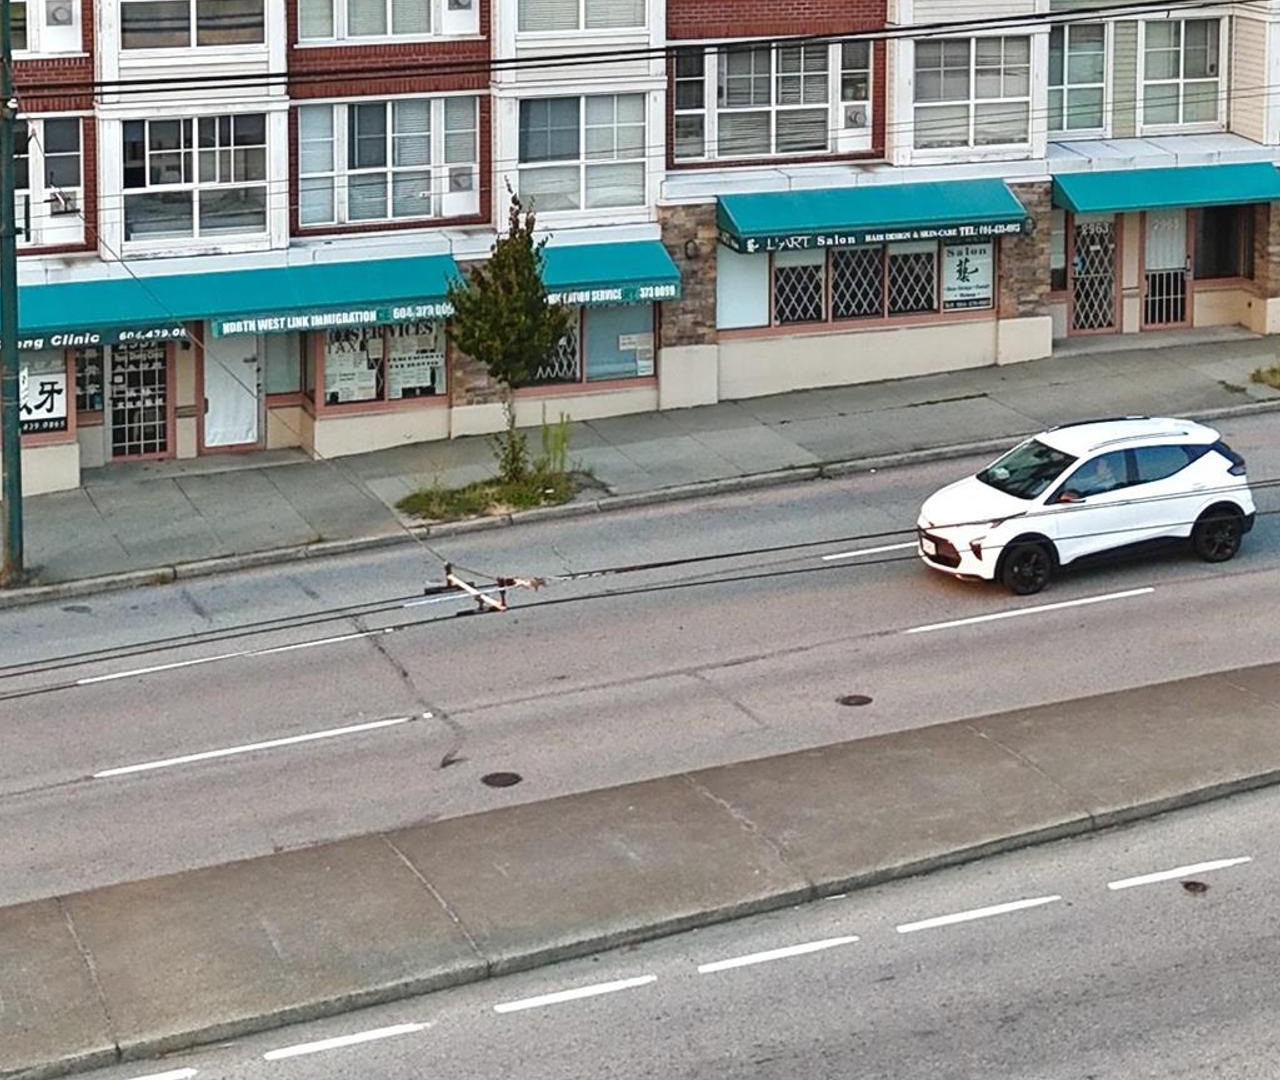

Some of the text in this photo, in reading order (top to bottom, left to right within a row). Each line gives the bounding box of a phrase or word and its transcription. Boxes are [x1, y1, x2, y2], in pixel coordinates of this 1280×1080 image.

[817, 234, 856, 246] Salon
[946, 246, 986, 257] Salon
[222, 320, 257, 335] NORTH
[257, 318, 286, 331] WEST
[287, 315, 310, 328] LINK
[311, 309, 377, 326] IMMIGRATION
[51, 332, 100, 347] Clinic
